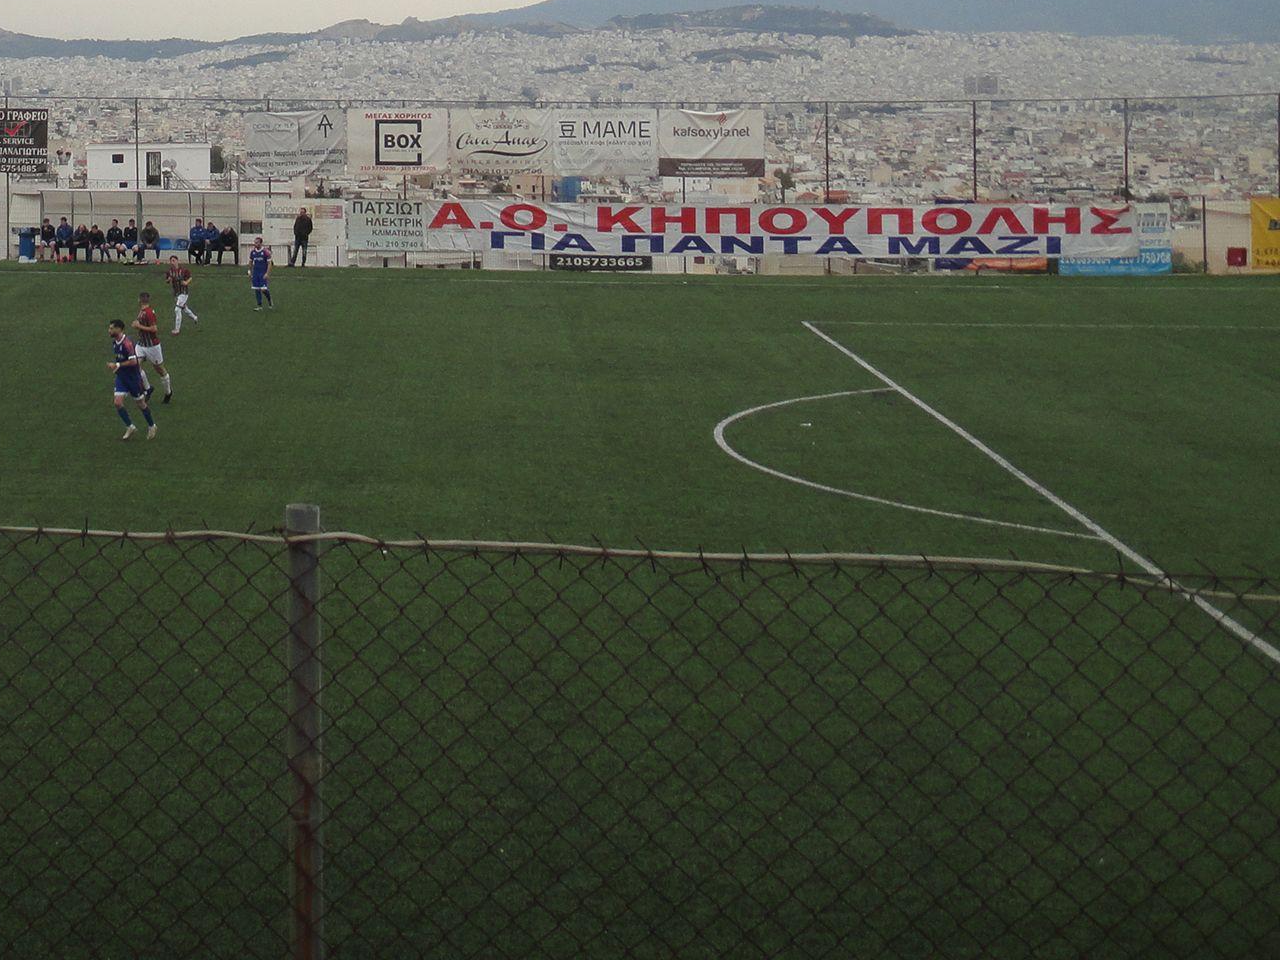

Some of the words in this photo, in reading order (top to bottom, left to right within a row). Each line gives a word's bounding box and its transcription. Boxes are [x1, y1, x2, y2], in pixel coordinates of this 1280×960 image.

[7, 110, 48, 122] ΓΡΑΦΕΙΟ
[583, 121, 651, 138] MAME
[673, 126, 751, 140] kafsoxyla.net
[3, 137, 35, 145] SERVICE
[384, 134, 422, 149] BOX
[353, 201, 423, 215] ΠΑΤΣΙΩΤ
[366, 217, 423, 228] ΗΛΕΚΤΡΙΚ
[597, 205, 1133, 235] ΚΗΠΟΥΠΟΛΗΣ
[385, 240, 399, 248] 210
[491, 231, 598, 252] ΓΙΑ
[622, 234, 864, 255] ΠΑΝΤΑ
[888, 236, 1062, 255] ΜΑΖΙ
[556, 256, 644, 267] 2105733665
